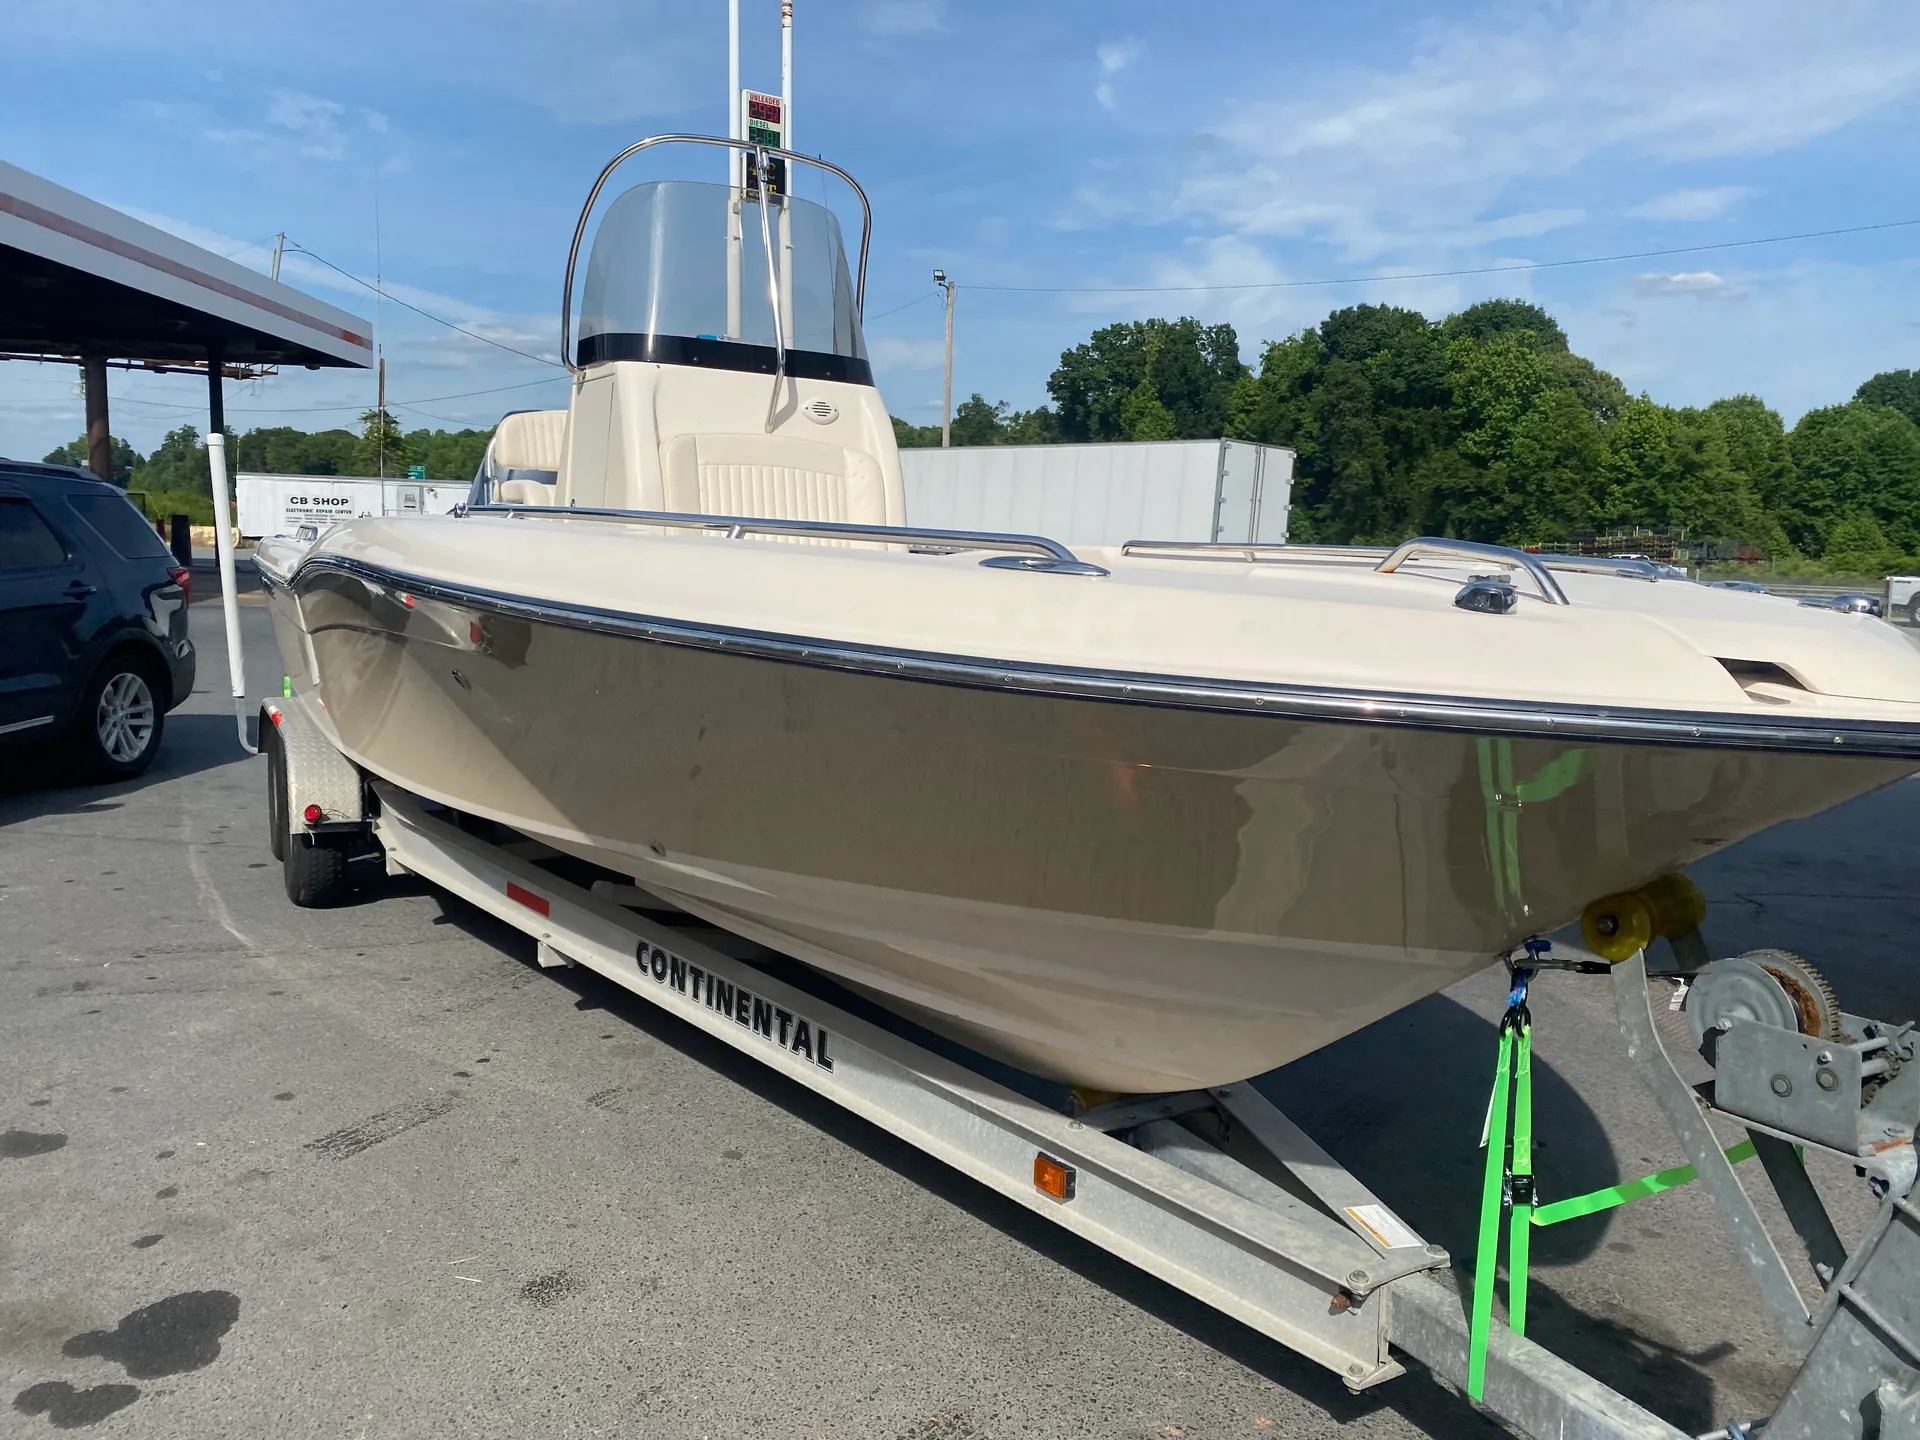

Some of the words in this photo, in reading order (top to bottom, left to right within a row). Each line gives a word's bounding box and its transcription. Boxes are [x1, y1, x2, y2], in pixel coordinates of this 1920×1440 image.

[750, 94, 780, 106] UNLEADED
[750, 119, 769, 129] DIESEL
[290, 496, 308, 504] CB
[313, 497, 349, 506] SHOP
[635, 939, 835, 1074] CONTINENTAL
